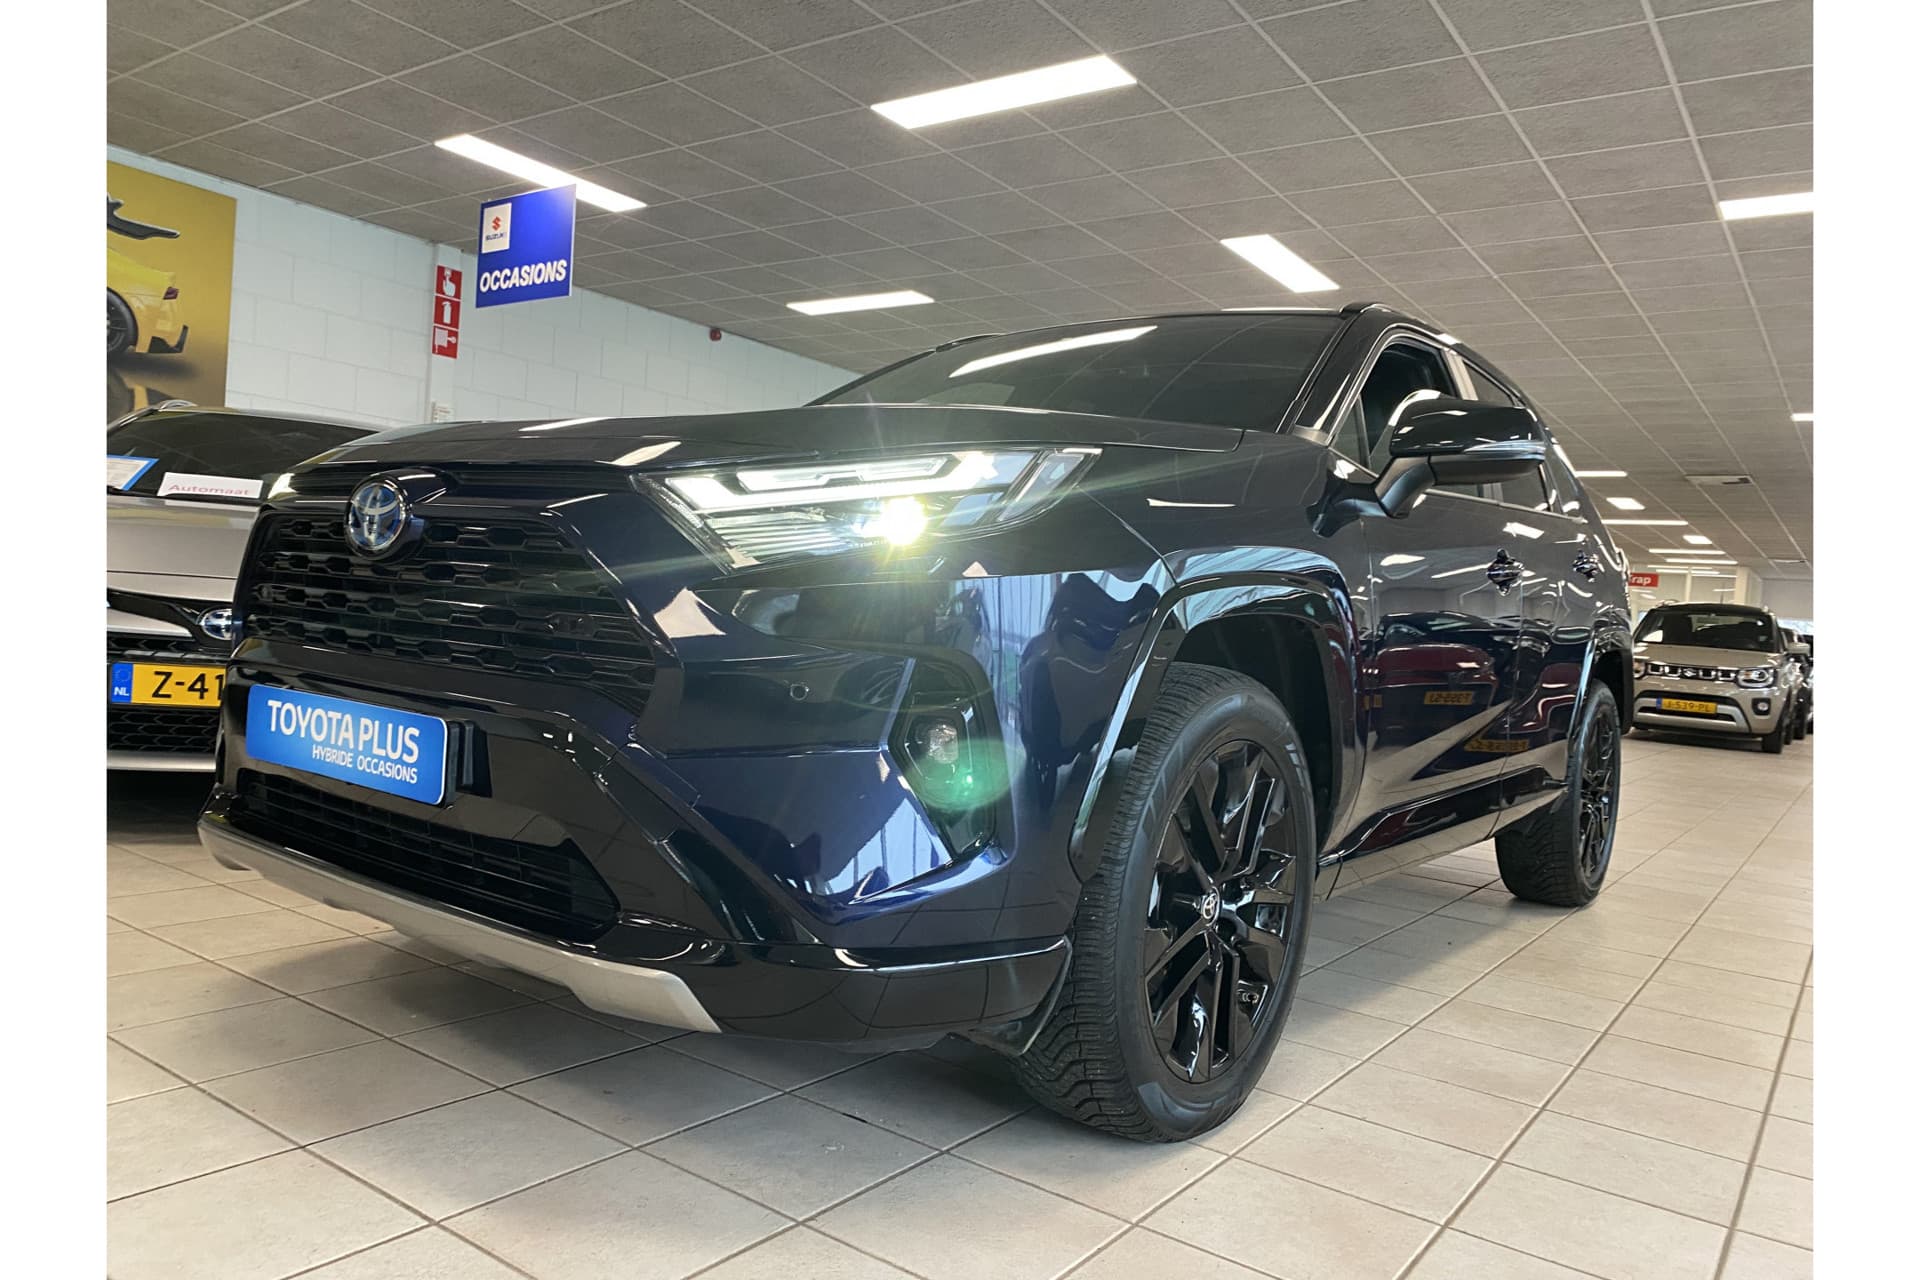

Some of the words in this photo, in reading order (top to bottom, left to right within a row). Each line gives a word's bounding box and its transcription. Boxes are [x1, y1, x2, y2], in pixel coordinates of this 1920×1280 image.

[480, 259, 568, 293] OCCASIONS
[168, 484, 250, 496] Automaat
[113, 686, 130, 697] NL
[267, 699, 355, 750] TOYOTA
[358, 717, 421, 764] PLUS
[312, 743, 354, 768] HYBRIDE
[356, 755, 418, 785] OCCASIONS
